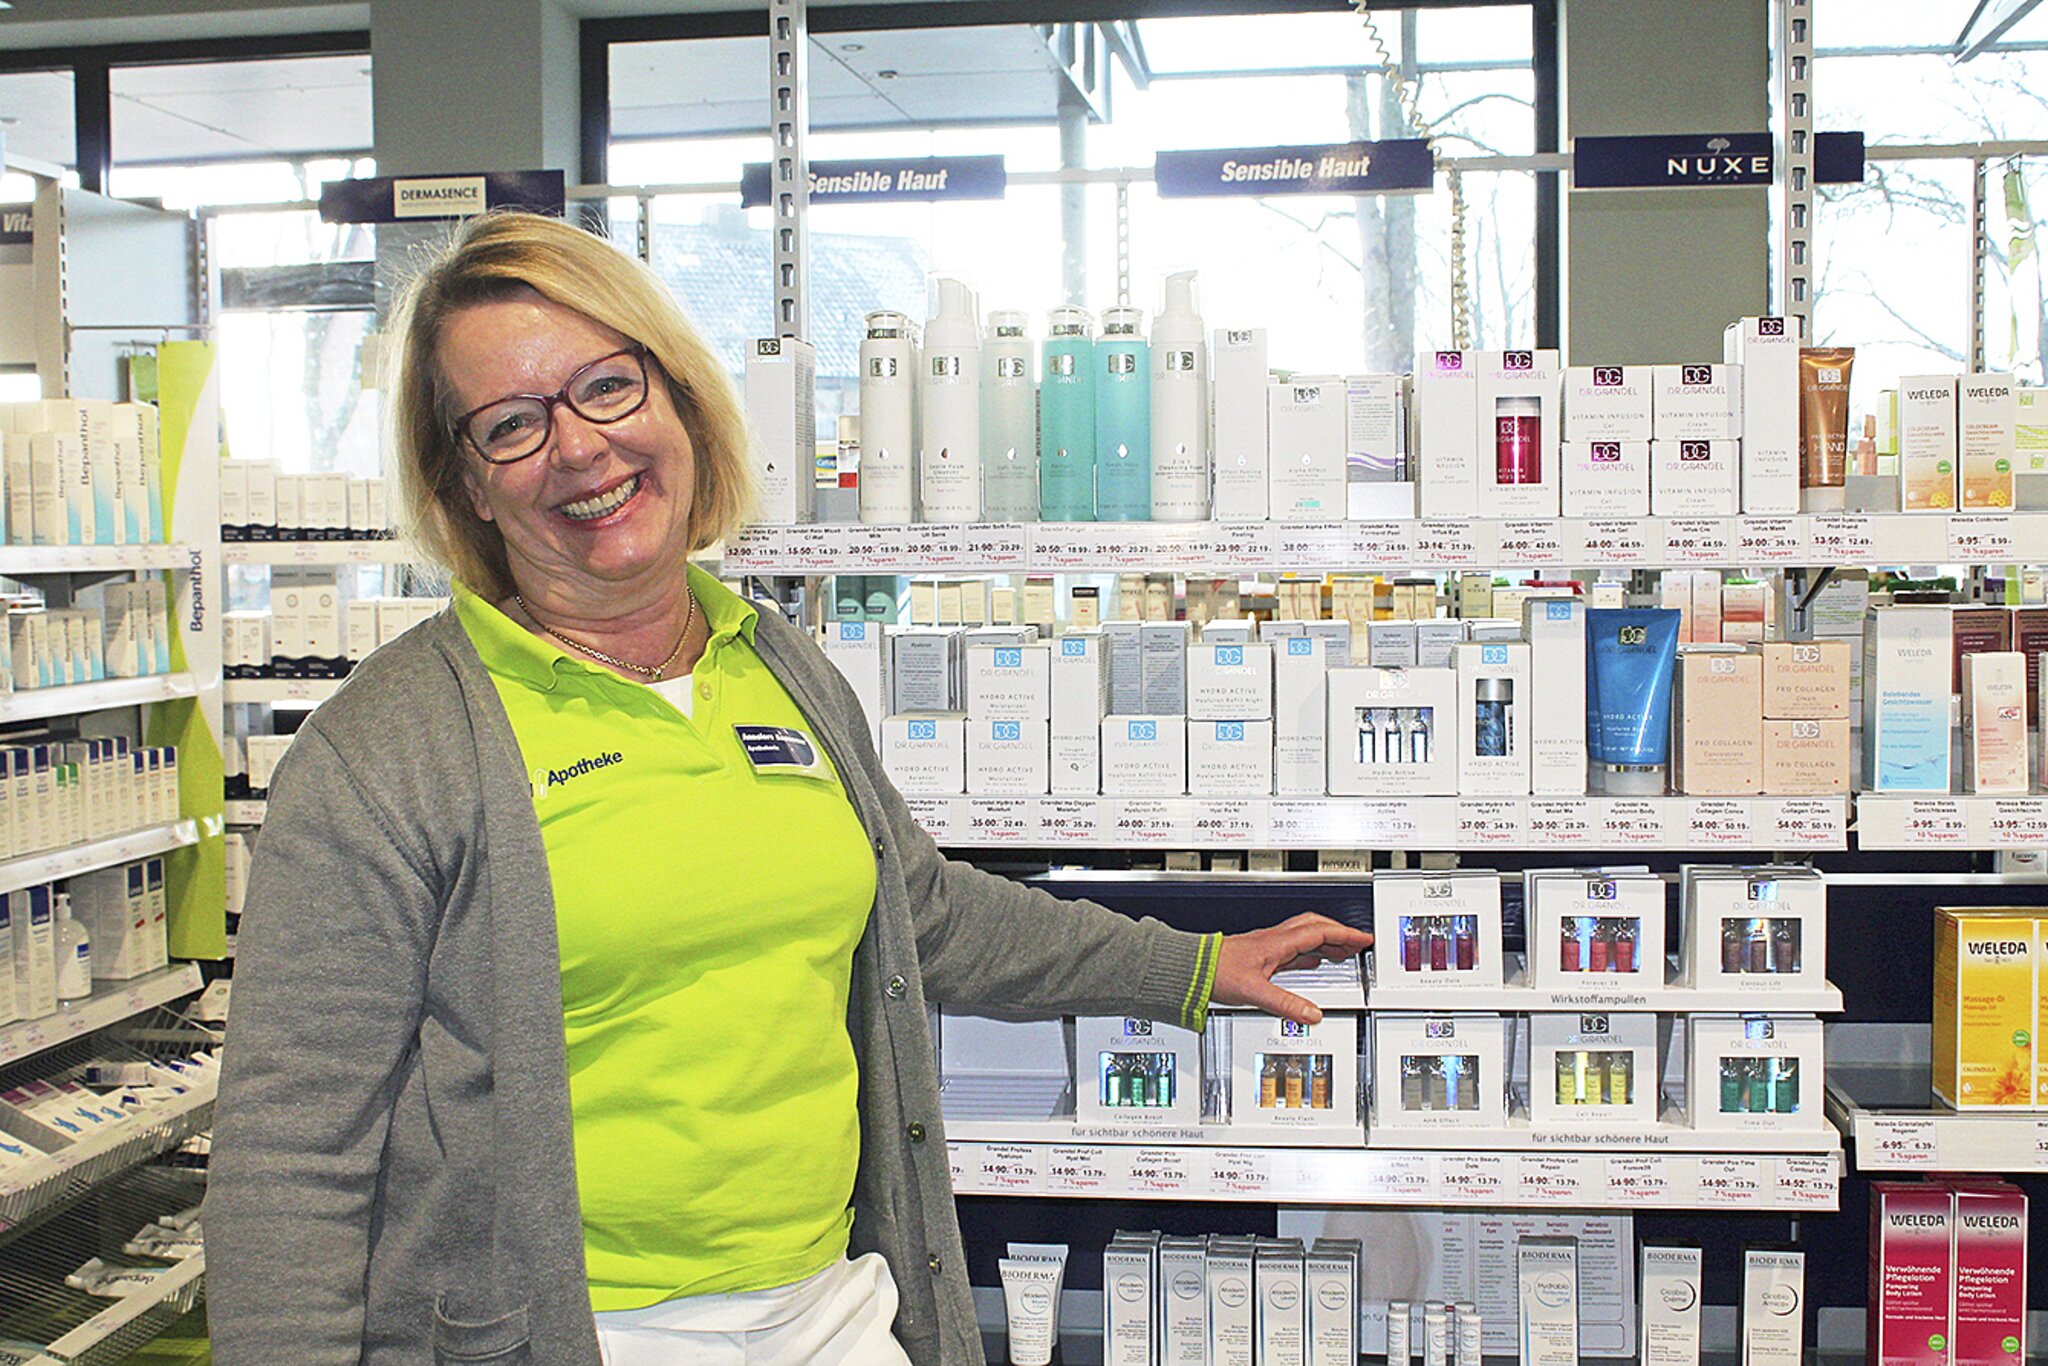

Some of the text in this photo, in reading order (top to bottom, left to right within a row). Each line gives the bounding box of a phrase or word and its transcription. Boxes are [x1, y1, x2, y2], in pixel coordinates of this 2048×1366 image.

[1221, 155, 1371, 183] Sensible Haut
[1667, 156, 1769, 176] NUXE
[897, 168, 948, 192] Haut
[401, 186, 478, 201] DERMASENCE
[1907, 389, 1950, 400] WELEDA
[1966, 387, 2009, 397] WELEDA
[80, 409, 91, 485] Bepanthol
[189, 549, 205, 633] Bepanthol
[548, 751, 623, 787] Apotheke
[1321, 860, 1361, 870] PHYSIOGEL
[1968, 942, 2028, 955] WELEDA
[1551, 994, 1647, 1005] Wirkstoffampullen
[1071, 1127, 1205, 1139] für sichtbar schönere Haut
[1532, 1133, 1669, 1144] für sichtbar schönere Haut
[1890, 1214, 1945, 1227] WELEDA
[1964, 1215, 2019, 1228] WELEDA
[1107, 1255, 1146, 1263] BIODERMA
[1522, 1251, 1572, 1260] BIODERMA
[1647, 1253, 1697, 1262] BIODERMA
[1750, 1257, 1800, 1265] BIODERMA
[1885, 1265, 1942, 1274] Verwöhnende
[1959, 1267, 2015, 1276] Verwöhnende
[1002, 1270, 1056, 1280] BIODERMA
[1885, 1274, 1936, 1283] Pflegelotion
[1959, 1276, 2009, 1284] Pflegelotion
[1885, 1283, 1919, 1291] Pampering
[1959, 1285, 1992, 1293] Pampering
[1885, 1290, 1901, 1298] Body
